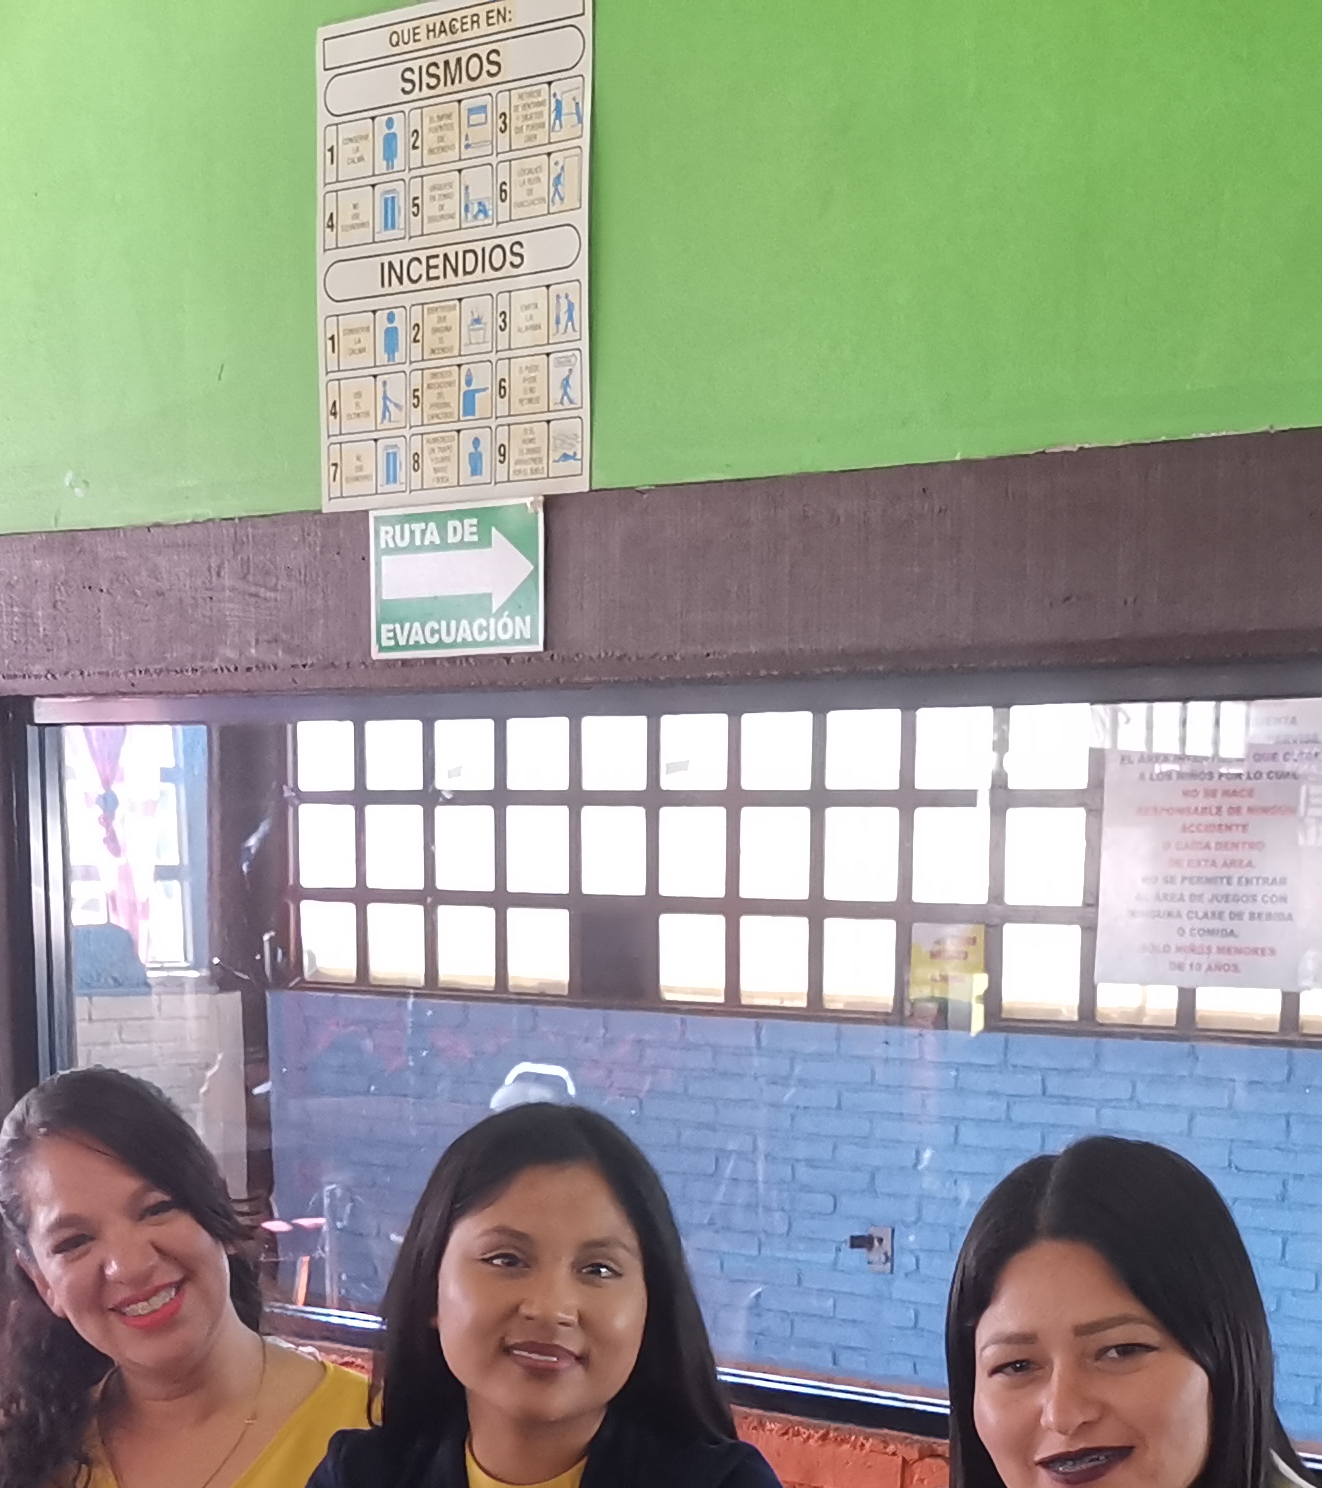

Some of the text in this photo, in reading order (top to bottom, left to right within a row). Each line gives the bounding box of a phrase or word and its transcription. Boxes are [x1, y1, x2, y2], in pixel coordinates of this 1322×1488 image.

[389, 6, 513, 47] QUE HACER EN:
[400, 48, 503, 96] SISMOS
[498, 111, 508, 134] 3
[411, 129, 420, 151] 2
[327, 145, 335, 166] 1
[499, 181, 508, 203] 6
[411, 196, 420, 217] 5
[325, 211, 335, 232] 4
[379, 240, 525, 289] INCENDIOS
[498, 310, 507, 332] 3
[328, 333, 336, 354] 1
[412, 322, 421, 344] 2
[412, 387, 421, 409] 5
[498, 377, 507, 399] 6
[329, 400, 338, 420] 4
[412, 452, 420, 473] 8
[497, 443, 506, 464] 9
[331, 463, 339, 482] 7
[379, 518, 479, 549] RUTA DE
[380, 611, 532, 647] EVACUACIÓN
[1179, 875, 1234, 887] PERMITE
[1236, 875, 1288, 887] ENTRAR
[1207, 893, 1259, 904] JUEGOS
[1185, 909, 1226, 922] CLASE
[1228, 909, 1245, 922] DE
